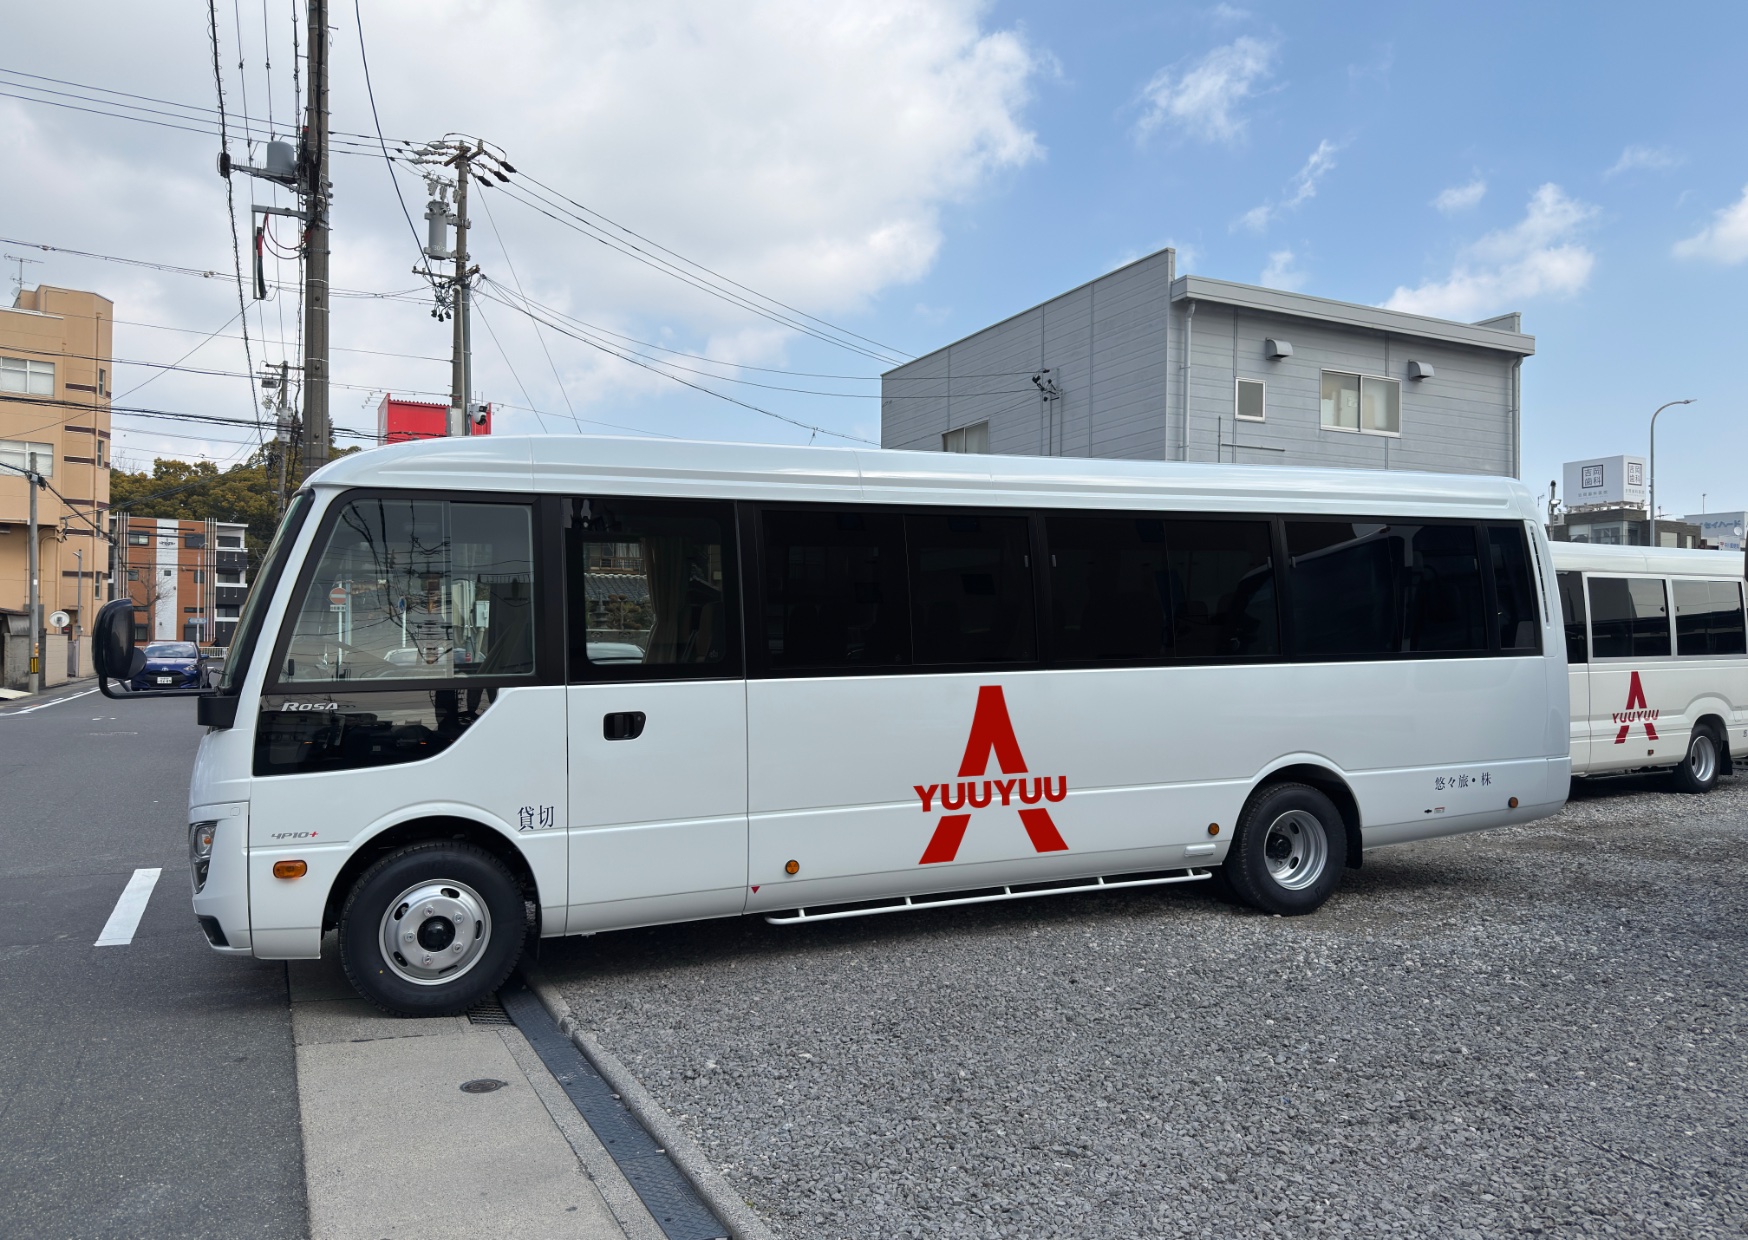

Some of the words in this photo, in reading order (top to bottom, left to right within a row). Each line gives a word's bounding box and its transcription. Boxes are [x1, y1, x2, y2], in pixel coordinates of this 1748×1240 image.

[1700, 520, 1742, 529] セイハード
[281, 702, 338, 712] ROSA
[1612, 709, 1660, 724] YUUYUU
[913, 775, 1067, 813] YUUYUU
[517, 804, 555, 832] 貸切
